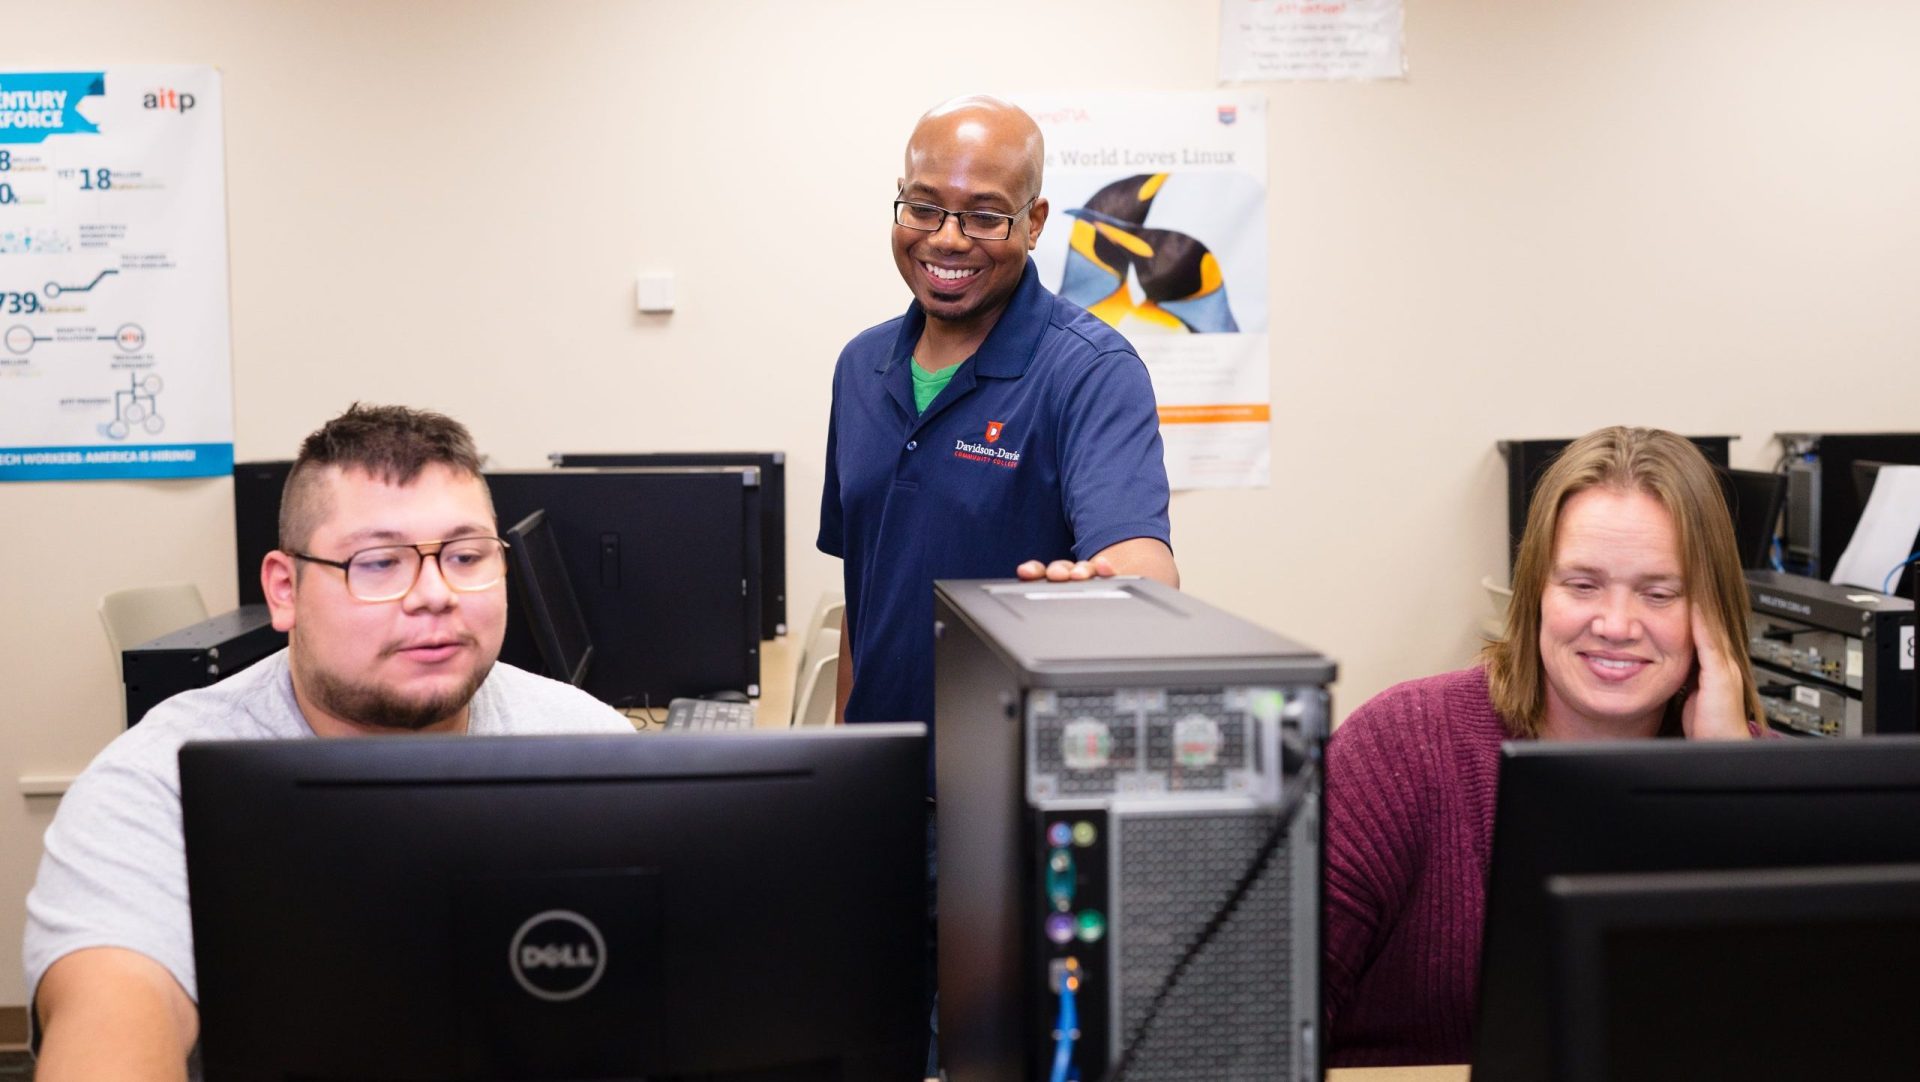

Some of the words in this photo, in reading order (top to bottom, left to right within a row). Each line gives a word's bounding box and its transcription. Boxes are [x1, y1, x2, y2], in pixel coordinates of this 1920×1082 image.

[0, 90, 67, 109] NTURY
[143, 88, 195, 114] aitp
[1060, 149, 1118, 166] World
[1124, 149, 1176, 166] Loves
[1183, 148, 1236, 165] Linux
[80, 168, 112, 190] 18
[86, 451, 138, 464] AMERICA
[521, 943, 596, 969] DELL
